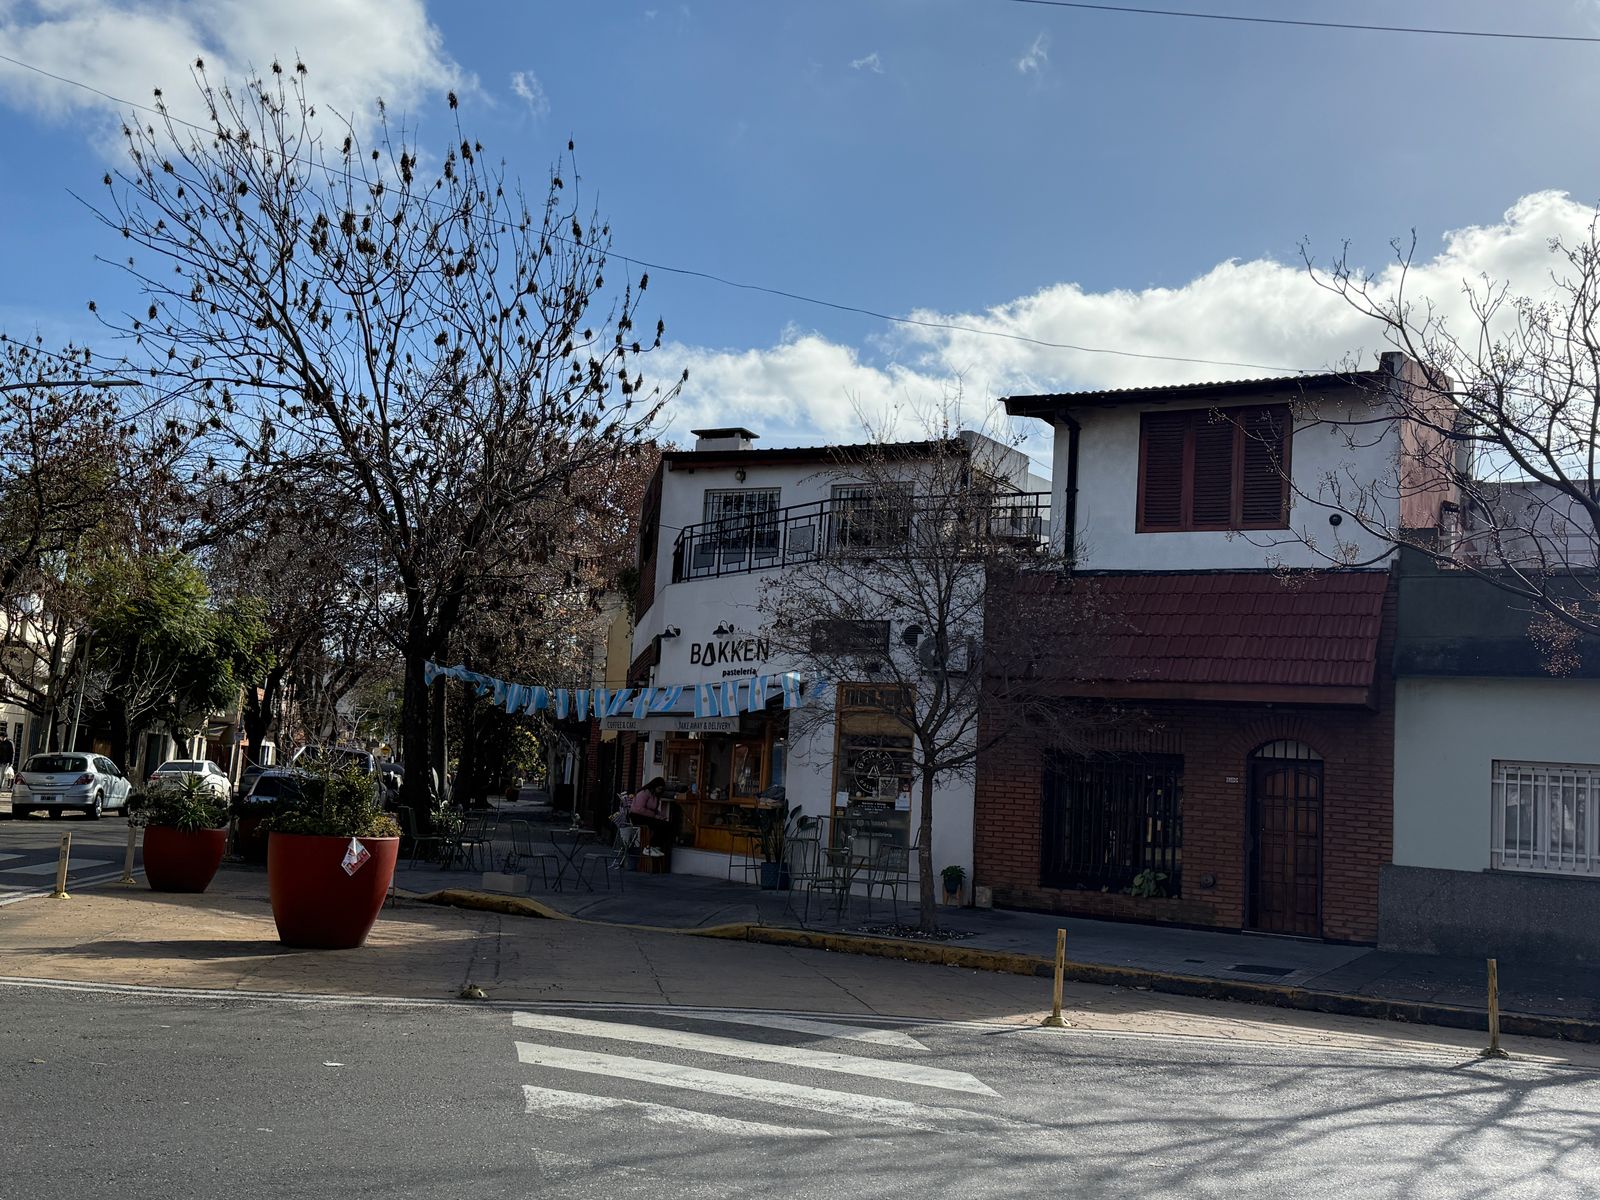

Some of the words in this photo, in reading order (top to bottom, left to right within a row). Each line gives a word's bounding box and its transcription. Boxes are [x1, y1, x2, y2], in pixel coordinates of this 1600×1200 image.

[690, 638, 770, 666] BAKKEN
[607, 721, 622, 729] COFFEE
[626, 721, 637, 729] CAKE
[707, 721, 731, 730] DELIVERY
